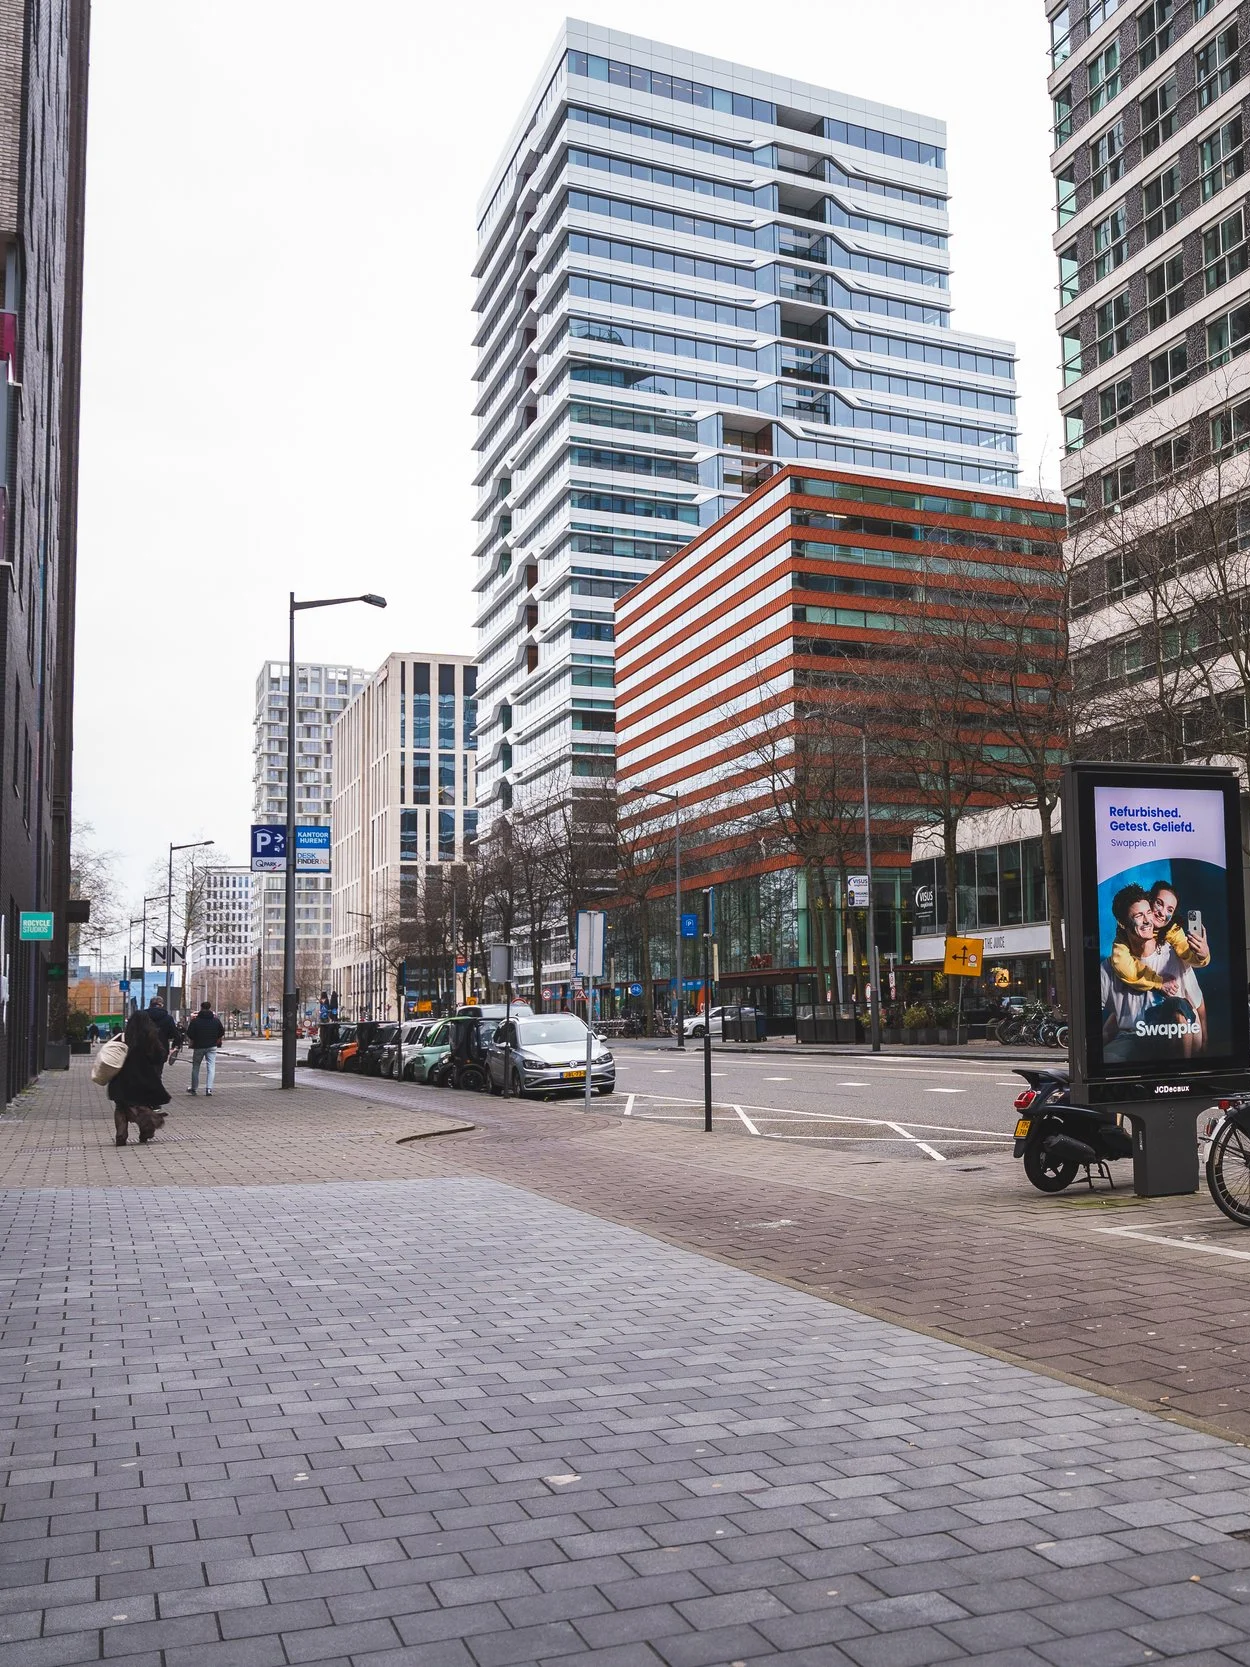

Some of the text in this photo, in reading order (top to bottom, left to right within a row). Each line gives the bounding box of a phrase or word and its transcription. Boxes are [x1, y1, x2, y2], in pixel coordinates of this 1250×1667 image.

[1109, 806, 1181, 818] Refurbished.
[1110, 820, 1195, 833] Getest. Geliefd.
[1111, 838, 1157, 849] Swappie.nl
[920, 890, 933, 902] VISUS
[22, 919, 52, 927] ROCYCLE
[1135, 1018, 1201, 1039] Swappie
[1154, 1085, 1190, 1094] JCDecaux
